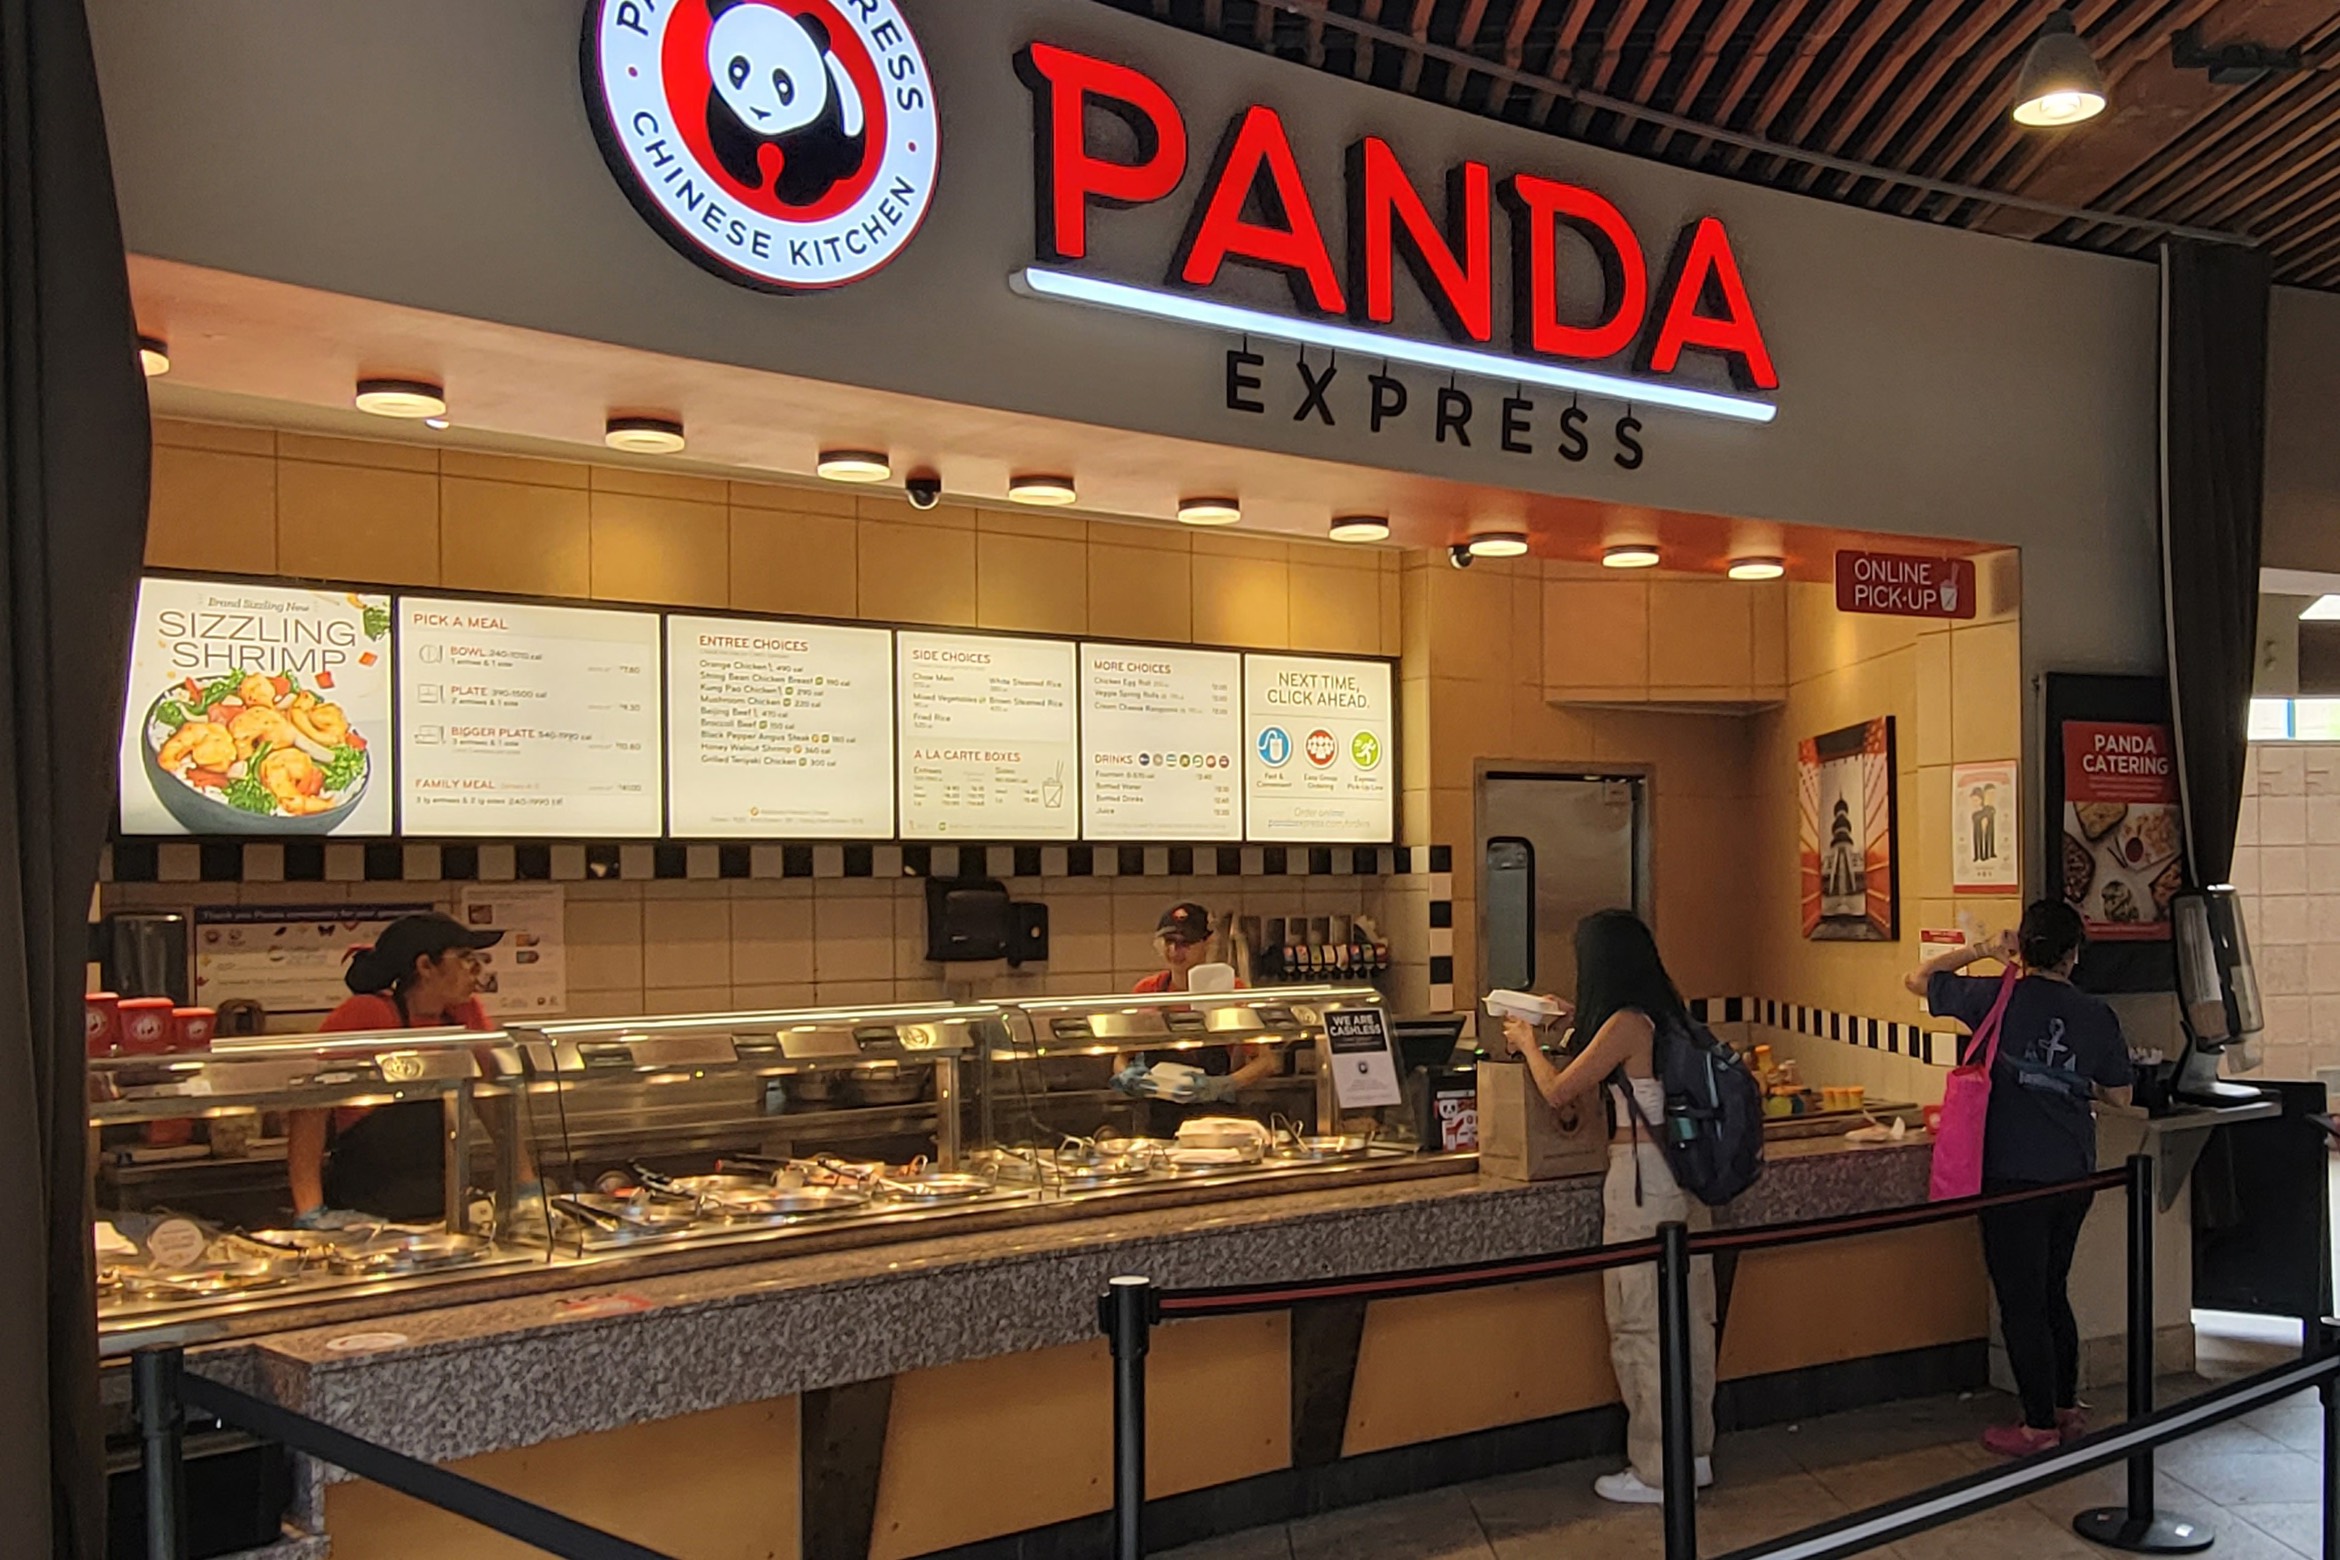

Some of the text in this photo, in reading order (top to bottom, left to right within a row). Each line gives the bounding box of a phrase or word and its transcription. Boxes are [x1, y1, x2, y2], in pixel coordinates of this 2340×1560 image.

[632, 111, 916, 267] CHINESE KITCHEN
[1030, 42, 1779, 391] PANDA
[1225, 349, 1643, 471] EXPRESS
[1854, 557, 1933, 586] ONLINE
[207, 596, 310, 613] Brand Sizzling New
[413, 613, 508, 630] PICK A MEAL
[158, 611, 356, 647] SIZZLING
[699, 635, 809, 652] ENTREE CHOICES
[172, 641, 347, 673] SHRIMP
[450, 646, 485, 657] BOWL
[912, 649, 991, 664] SIDE CHOICES
[700, 659, 731, 670] Orange
[734, 661, 768, 670] Chicken
[1094, 660, 1172, 675] MORE CHOICES
[700, 671, 726, 682] String
[728, 672, 750, 681] Bean
[752, 674, 785, 683] Chicken
[787, 675, 814, 684] Breast
[912, 672, 954, 682] Chow Mein
[989, 676, 1062, 688] White Steamed Rice
[1094, 676, 1121, 685] Chicken
[1123, 678, 1136, 688] Egg
[1279, 672, 1361, 693] NEXT TIME,
[450, 686, 487, 697] PLATE
[700, 683, 723, 693] Kung
[725, 684, 742, 693] Pao
[743, 685, 777, 693] Chicken
[700, 694, 745, 704] Mushroom
[747, 696, 781, 705] Chicken
[912, 692, 977, 704] Mixed Vegetables
[1094, 689, 1117, 698] Veggie
[1119, 690, 1142, 700] Spring
[1267, 689, 1371, 709] CLICK AHEAD.
[989, 696, 1063, 708] Brown Steamed Rice
[1094, 702, 1144, 711] Cream Cheese
[700, 706, 730, 717] Beijing
[732, 707, 752, 716] Beef
[913, 711, 951, 722] Fried Rice
[701, 718, 734, 727] Broccoli
[737, 719, 757, 728] Beef
[451, 726, 496, 738] BIGGER
[499, 727, 536, 739] PLATE
[701, 730, 724, 738] Black
[726, 731, 756, 741] Pepper
[759, 732, 785, 742] Angus
[787, 733, 809, 742] Steak
[701, 742, 728, 752] Honey
[730, 743, 759, 751] Walnut
[762, 744, 792, 754] Shrimp
[2094, 733, 2157, 755] PANDA
[701, 754, 729, 763] Grilled
[730, 755, 761, 765] Teriyaki
[763, 756, 797, 765] Chicken
[914, 749, 1022, 763] A LA CARTE BOXES
[1094, 754, 1133, 765] DRINKS
[2083, 753, 2169, 775] CATERING
[1095, 770, 1125, 778] Fountain
[1264, 772, 1278, 780] Fast
[415, 778, 460, 790] FAMILY
[463, 779, 495, 790] MEAL
[1095, 782, 1121, 790] Bottled
[1096, 795, 1121, 803] Bottled
[1294, 806, 1317, 818] Order
[1332, 1015, 1373, 1026] WE ARE
[1330, 1024, 1381, 1036] CASHLESS
